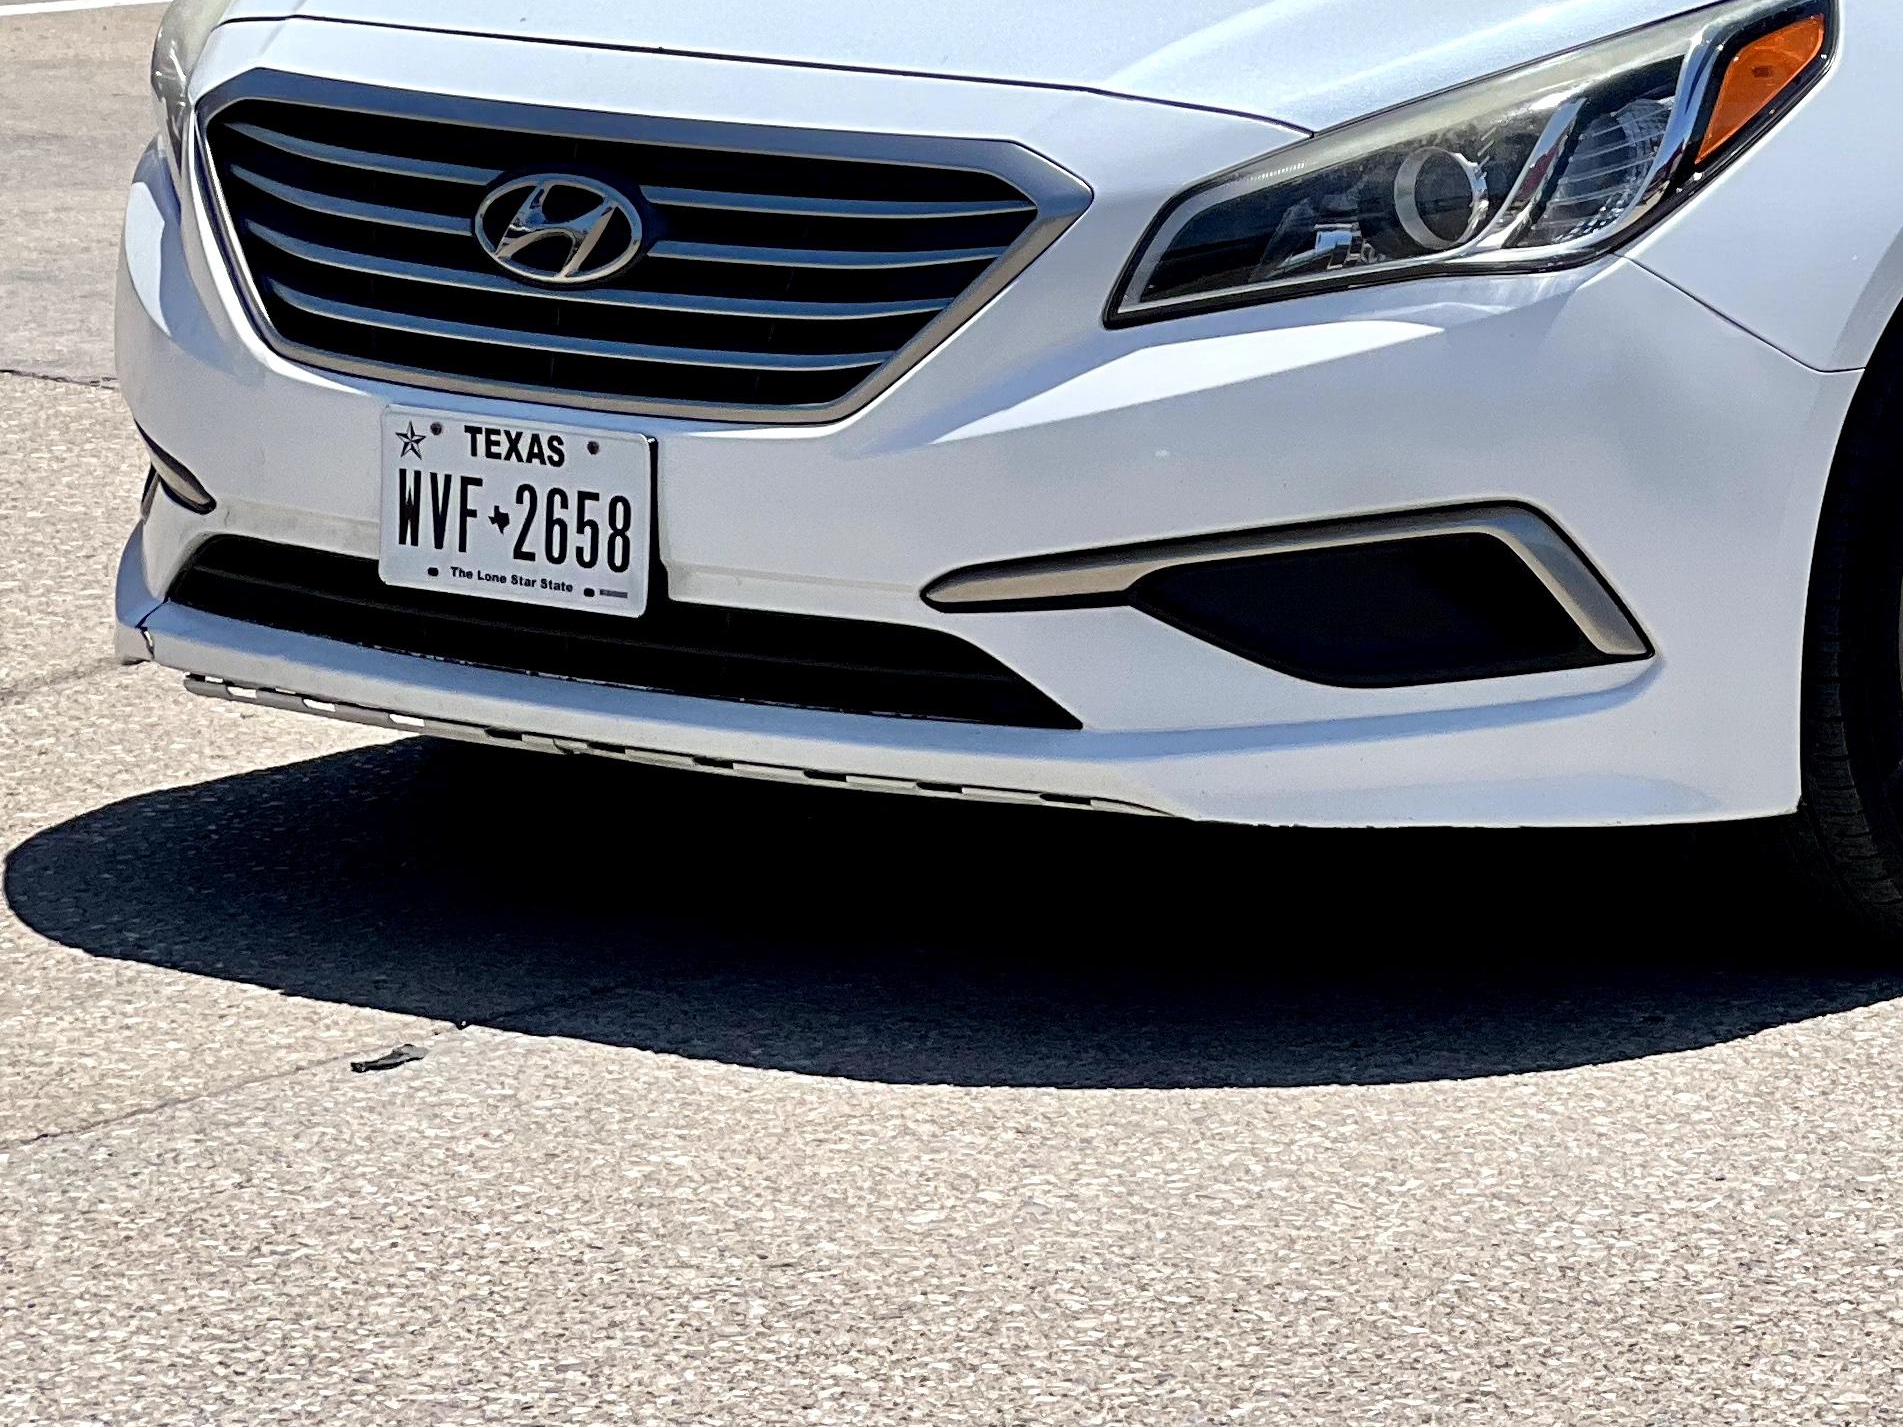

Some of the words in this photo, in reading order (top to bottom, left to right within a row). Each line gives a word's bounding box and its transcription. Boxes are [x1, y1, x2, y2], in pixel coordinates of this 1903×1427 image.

[464, 424, 566, 468] TEXAS
[398, 467, 484, 553] WVF
[512, 482, 632, 573] 2658
[450, 566, 473, 580] The
[477, 570, 507, 584] Lone
[510, 574, 537, 588] Star
[540, 578, 574, 593] State
